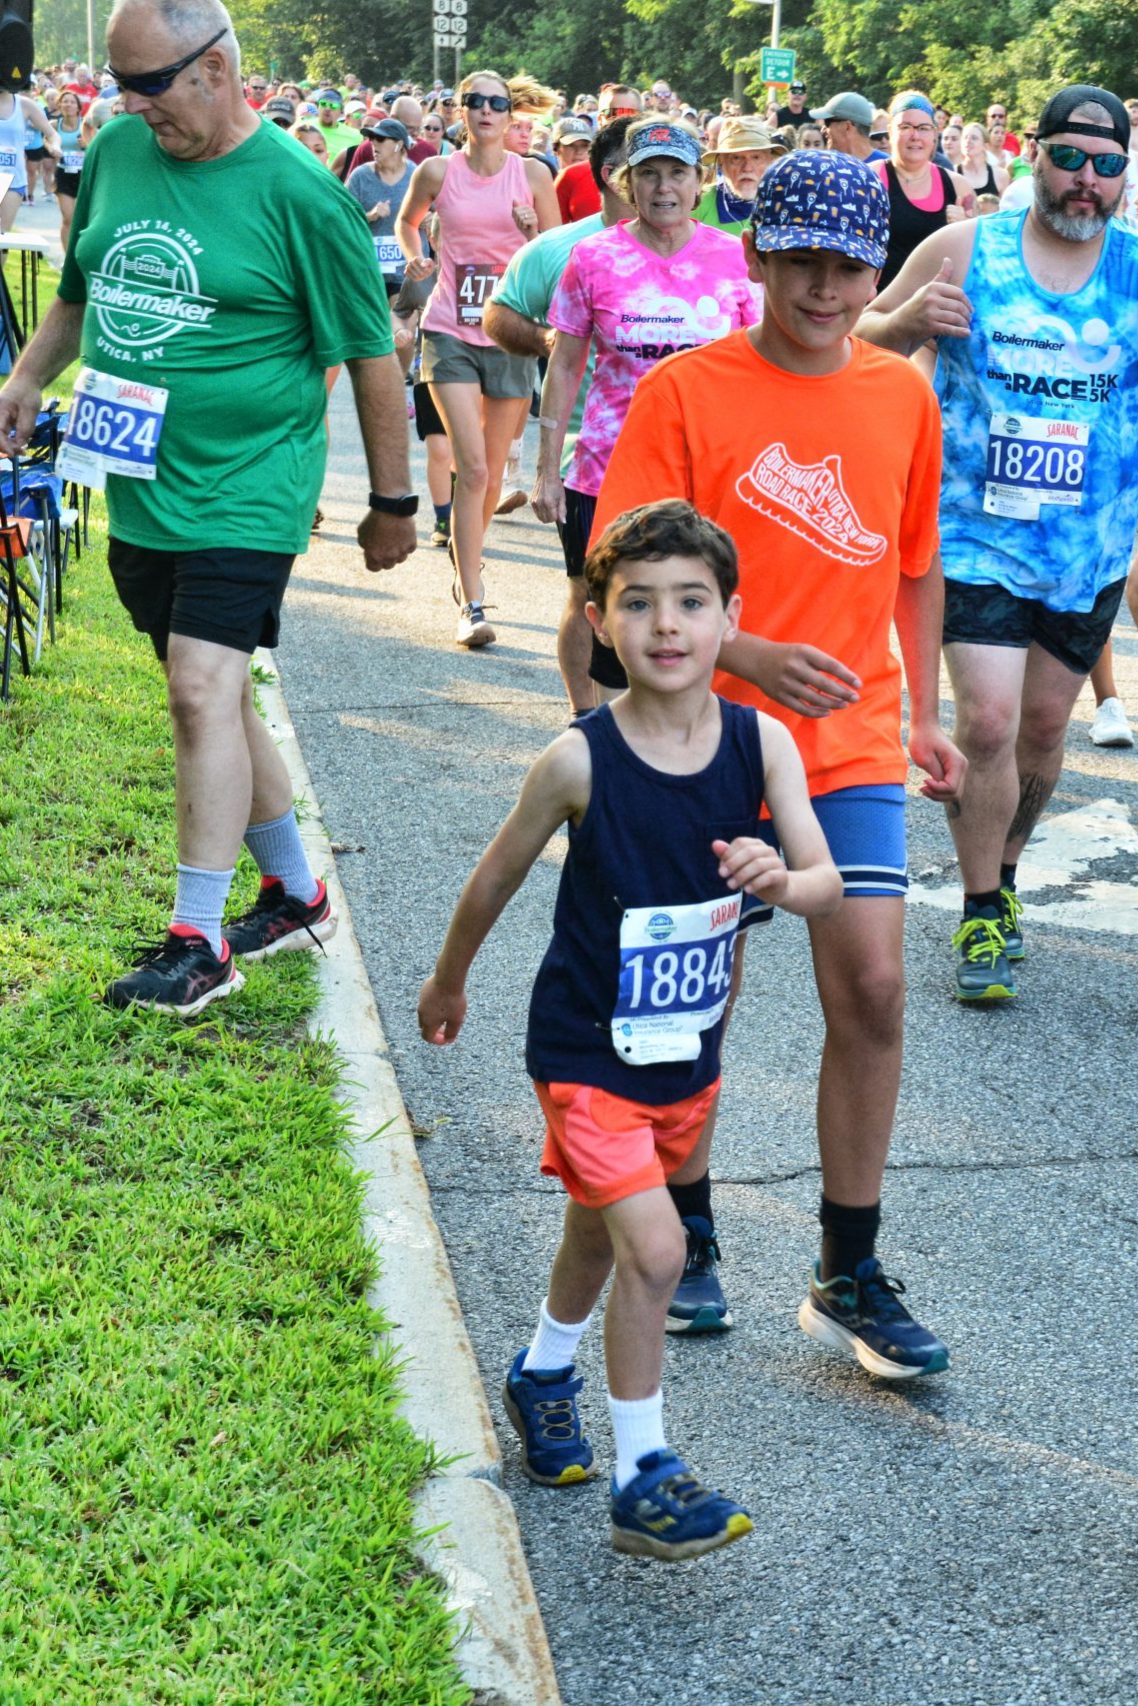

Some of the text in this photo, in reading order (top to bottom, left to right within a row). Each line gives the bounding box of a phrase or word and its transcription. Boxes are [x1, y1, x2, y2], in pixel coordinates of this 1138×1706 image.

[436, 19, 447, 30] 12
[453, 20, 464, 31] 12
[766, 66, 776, 80] E
[113, 219, 204, 255] JULY 14, 2024
[137, 262, 161, 274] 2024
[90, 277, 216, 322] Boilermaker
[620, 314, 685, 324] Boilermaker
[615, 324, 696, 344] MORE
[992, 330, 1065, 351] Boilermaker
[96, 336, 164, 362] UTICA, NY
[616, 344, 641, 353] than
[986, 369, 1012, 381] than
[1089, 373, 1119, 389] 15K
[1005, 372, 1088, 400] a RACE
[1089, 388, 1111, 403] 5K
[68, 396, 158, 457] 18624
[1046, 422, 1080, 441] SARANAC
[990, 440, 1084, 486] 18208
[763, 447, 835, 507] BOILERMAKER
[755, 462, 849, 544] ROAD RACE 2024
[842, 513, 860, 540] NEW
[854, 533, 883, 550] YORK
[649, 1020, 674, 1029] National
